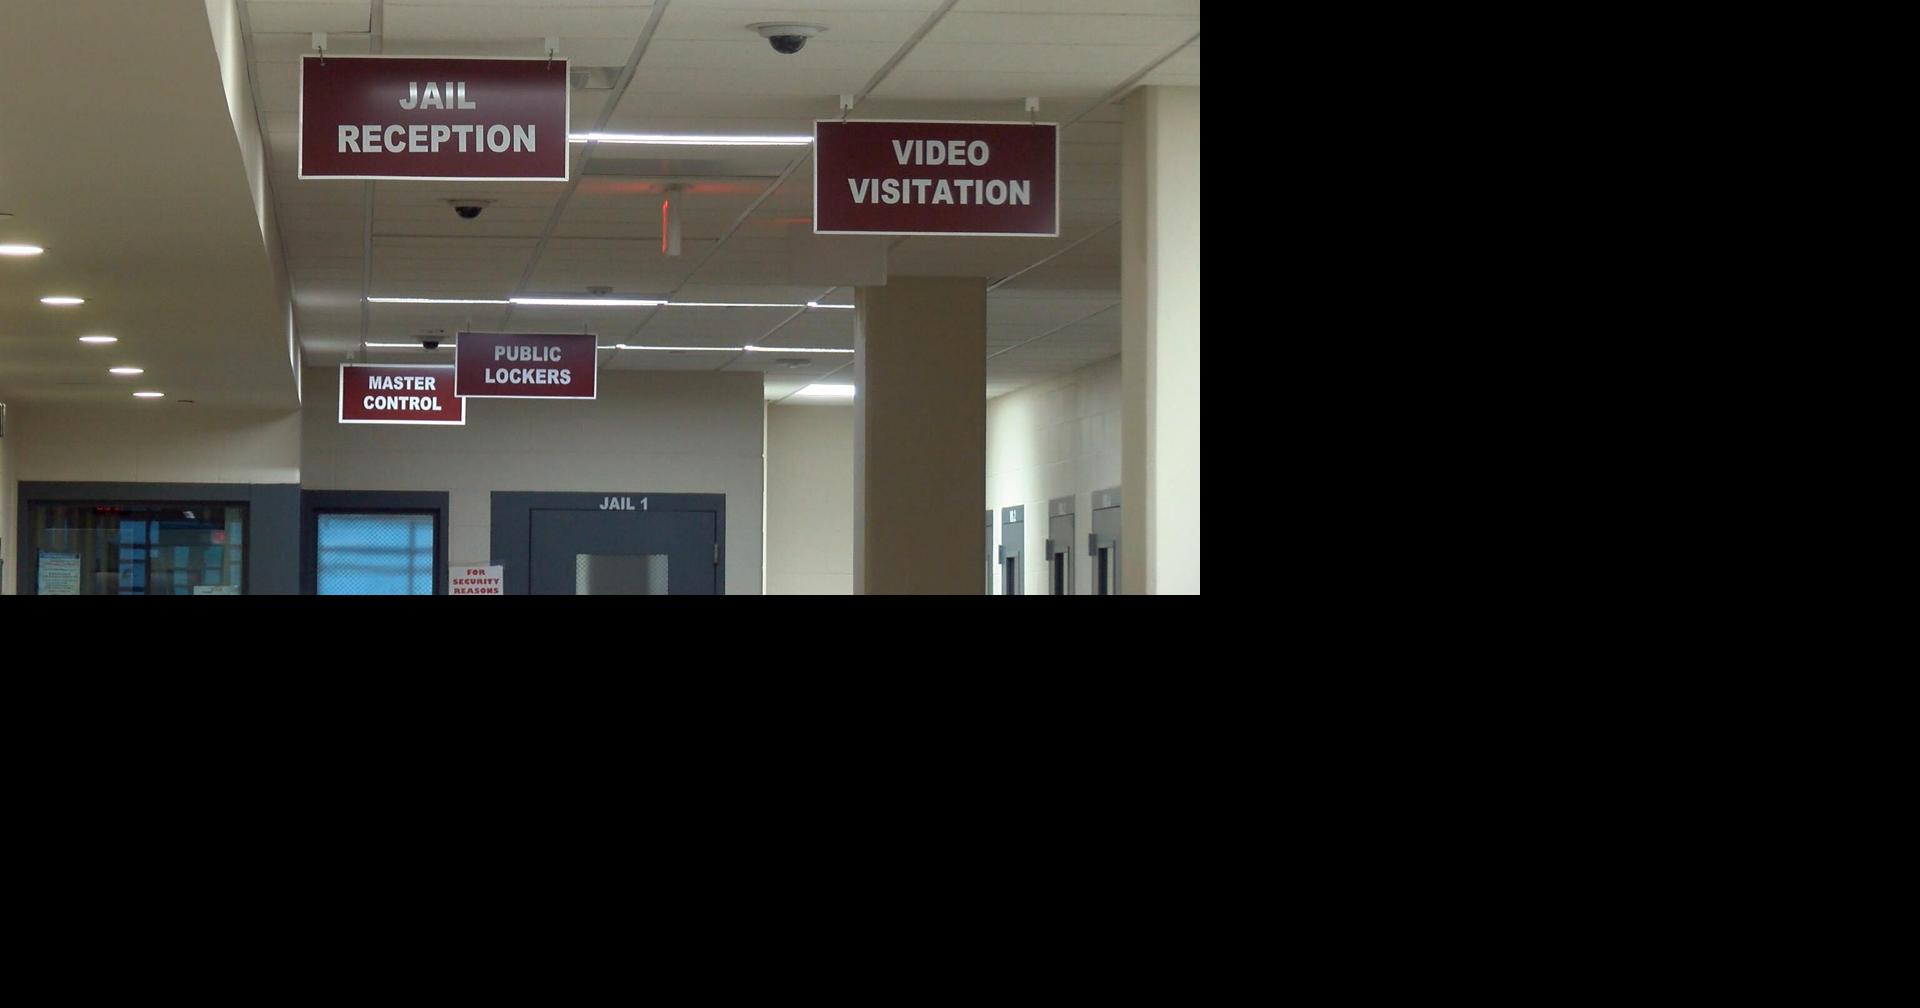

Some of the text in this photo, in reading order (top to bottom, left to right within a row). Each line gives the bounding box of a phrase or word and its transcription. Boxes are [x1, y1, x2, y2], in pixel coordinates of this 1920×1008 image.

[399, 81, 476, 110] JAIL
[338, 124, 536, 153] RECEPTION
[892, 140, 990, 166] VIDEO
[848, 178, 1031, 205] VISITATION
[494, 345, 562, 362] PUBLIC
[368, 375, 436, 391] MASTER
[485, 368, 571, 385] LOCKERS
[363, 396, 442, 411] CONTROL
[599, 496, 649, 511] JAIL 1
[467, 568, 486, 576] FOR
[454, 587, 499, 595] REASONS
